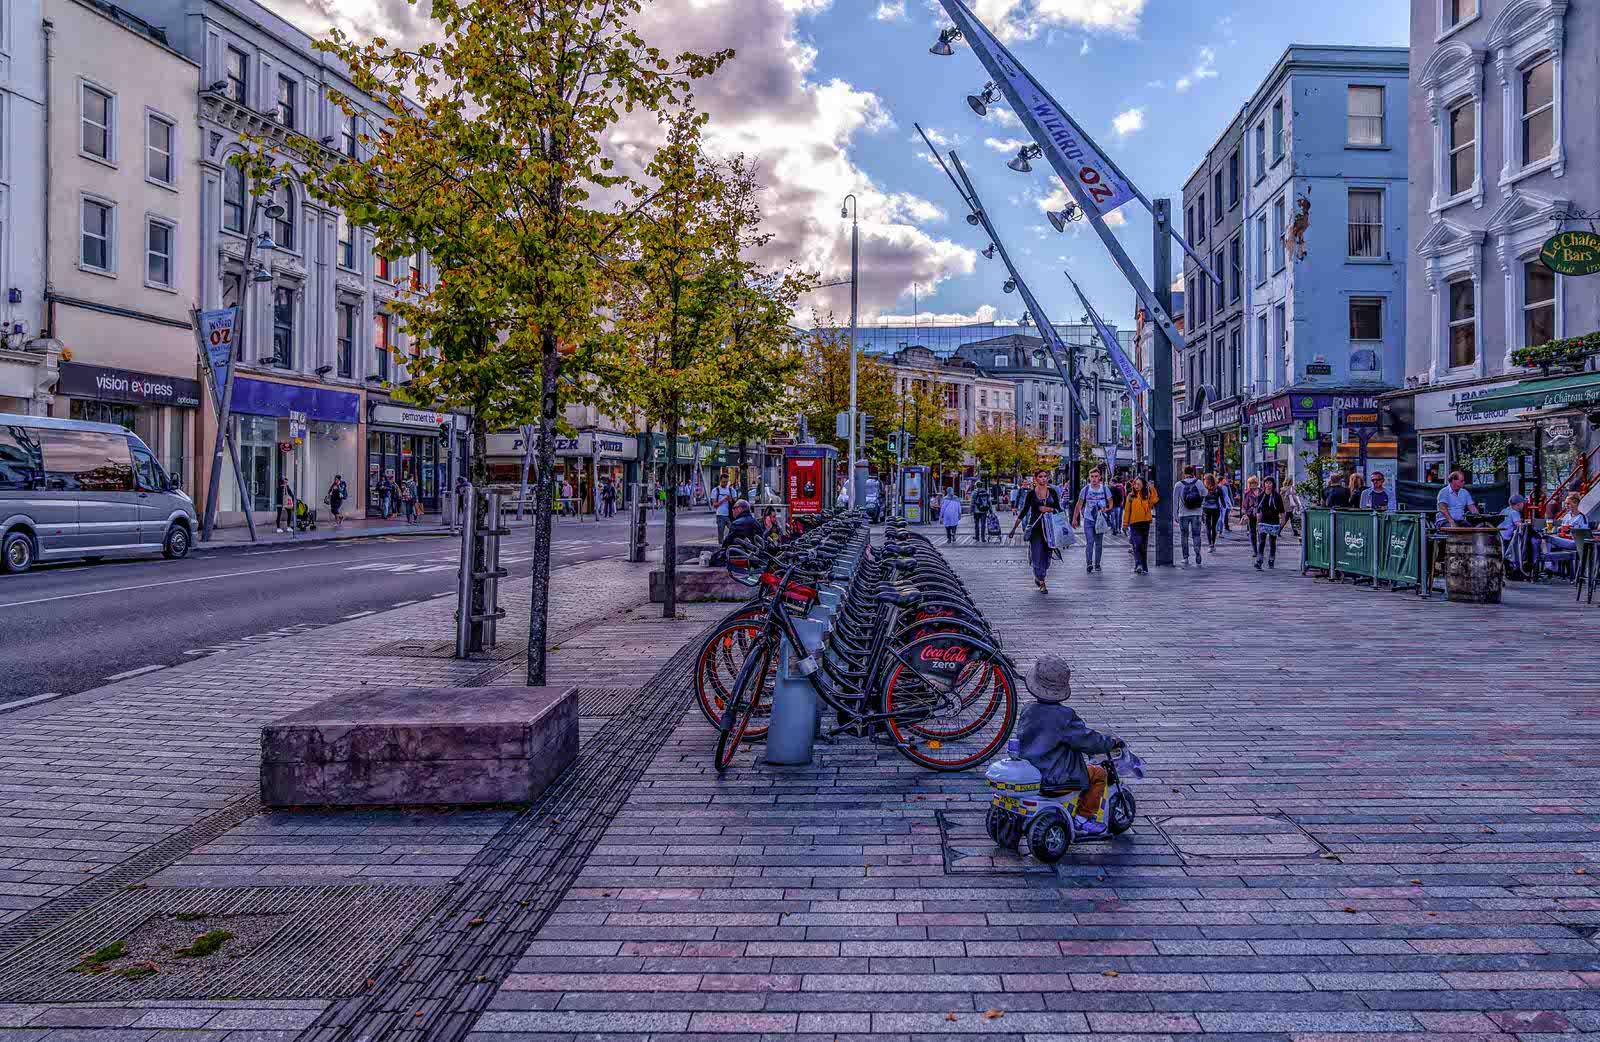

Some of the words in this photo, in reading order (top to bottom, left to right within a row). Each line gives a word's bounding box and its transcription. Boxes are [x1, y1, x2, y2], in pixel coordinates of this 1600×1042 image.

[1033, 102, 1085, 160] WIZARD
[1079, 166, 1113, 204] OZ
[1542, 241, 1561, 259] Le
[1560, 232, 1600, 253] Châtea
[1563, 248, 1593, 262] Bars
[210, 328, 232, 345] OZ
[96, 373, 128, 391] vision
[131, 380, 173, 397] express
[1544, 395, 1552, 405] Le
[1553, 390, 1583, 404] Château
[1456, 412, 1481, 422] TRAVEL
[1484, 409, 1509, 419] GROUP
[932, 660, 956, 669] zero
